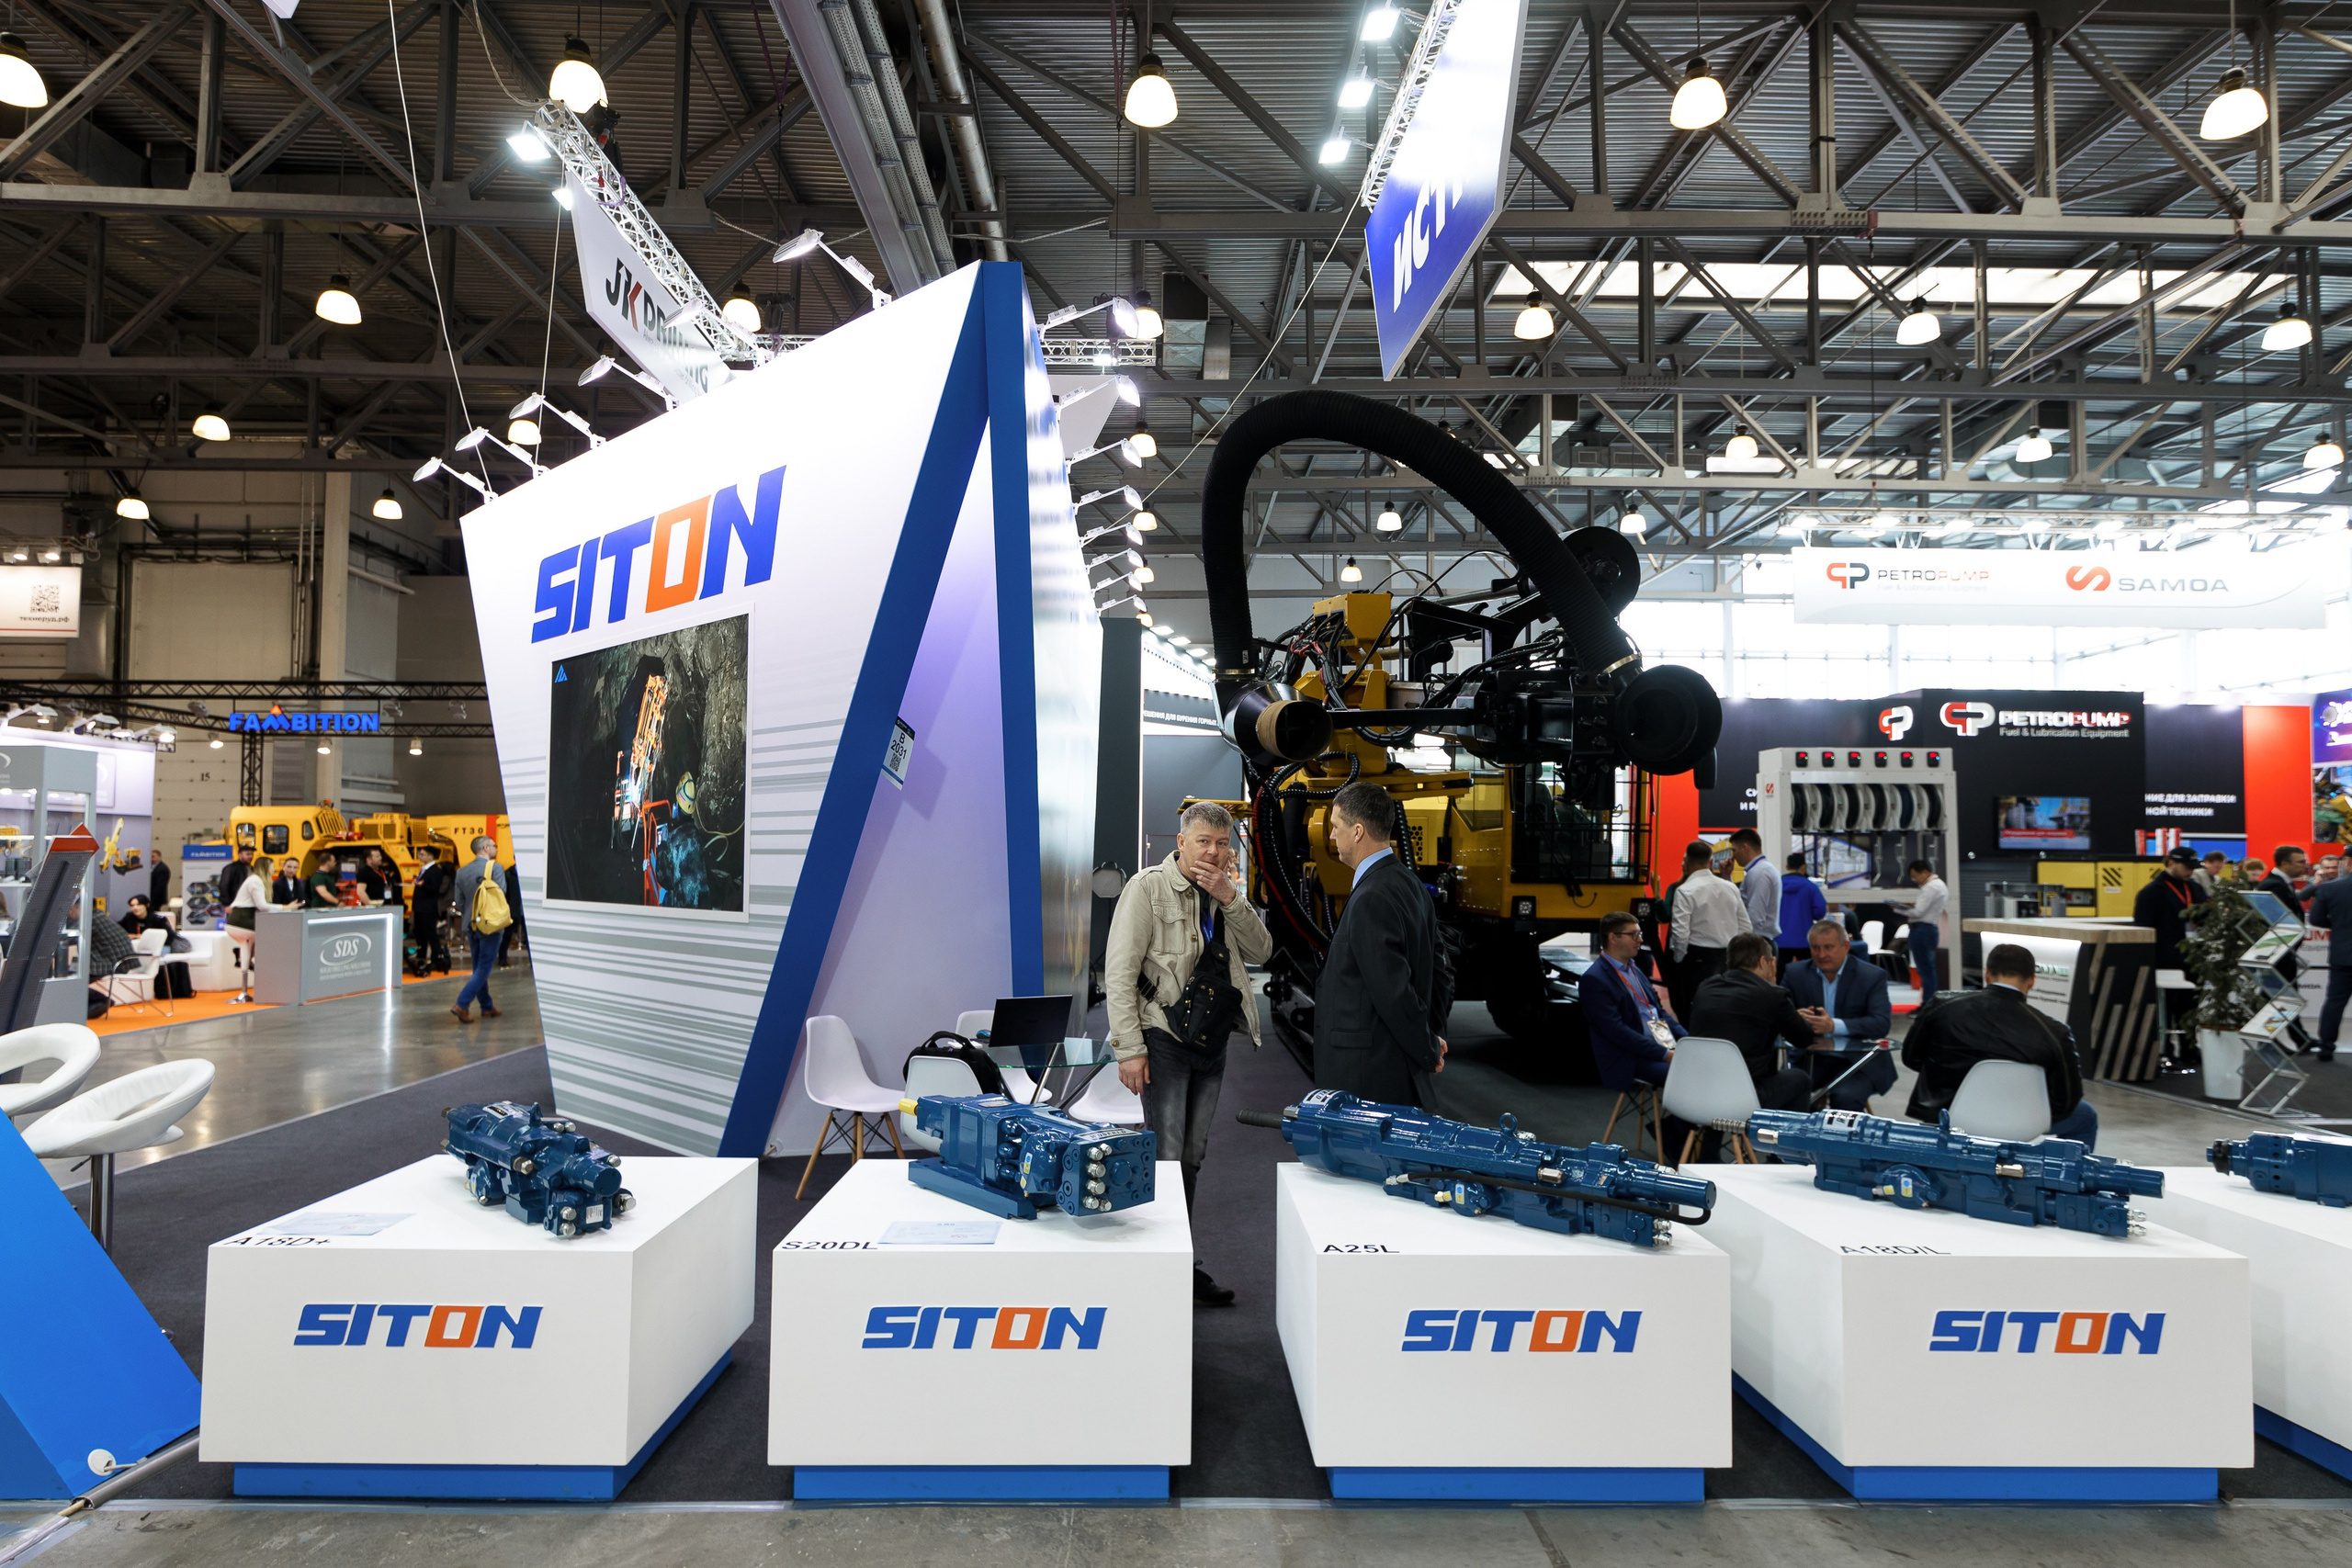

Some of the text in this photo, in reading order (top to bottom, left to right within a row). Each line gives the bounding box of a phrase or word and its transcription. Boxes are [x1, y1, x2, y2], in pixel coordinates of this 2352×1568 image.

[532, 466, 786, 643] SITON
[1877, 570, 1989, 581] PETROPUMP
[2119, 578, 2229, 592] SAMOA
[229, 711, 380, 731] FAMBITION
[1998, 711, 2132, 728] PETROPUMP
[1999, 728, 2130, 739] Fuel & Lubrication Equipment
[890, 739, 907, 760] 2031
[334, 938, 360, 958] SDS
[223, 1236, 331, 1247] A18D+
[782, 1241, 877, 1250] S20DL
[1323, 1245, 1400, 1254] A25L
[294, 1304, 543, 1348] SITON
[862, 1306, 1107, 1349] SITON
[1401, 1310, 1643, 1352] SITON
[1929, 1311, 2165, 1354] SITON
